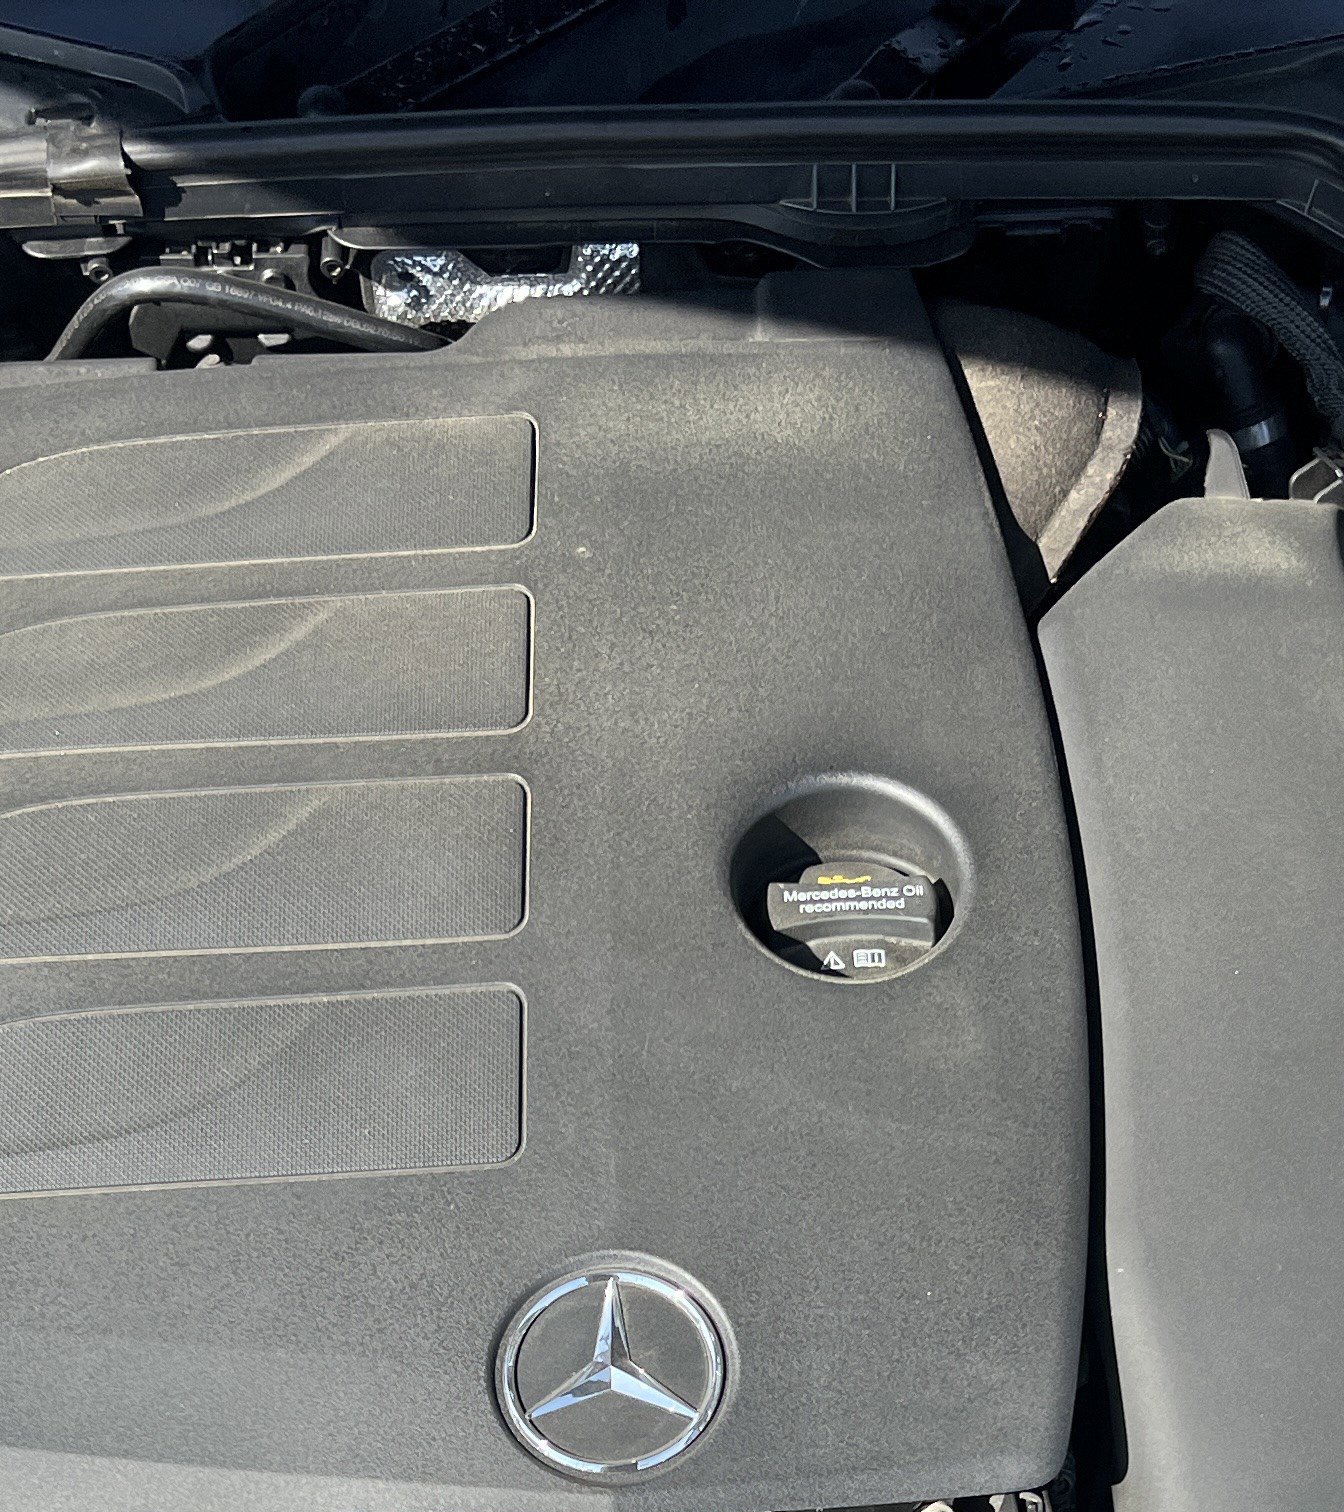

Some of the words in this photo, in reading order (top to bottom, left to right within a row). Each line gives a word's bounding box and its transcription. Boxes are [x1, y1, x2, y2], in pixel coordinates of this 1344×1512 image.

[783, 886, 899, 903] Mercedes-Benz
[902, 884, 924, 897] Oil
[799, 898, 906, 914] recommended
